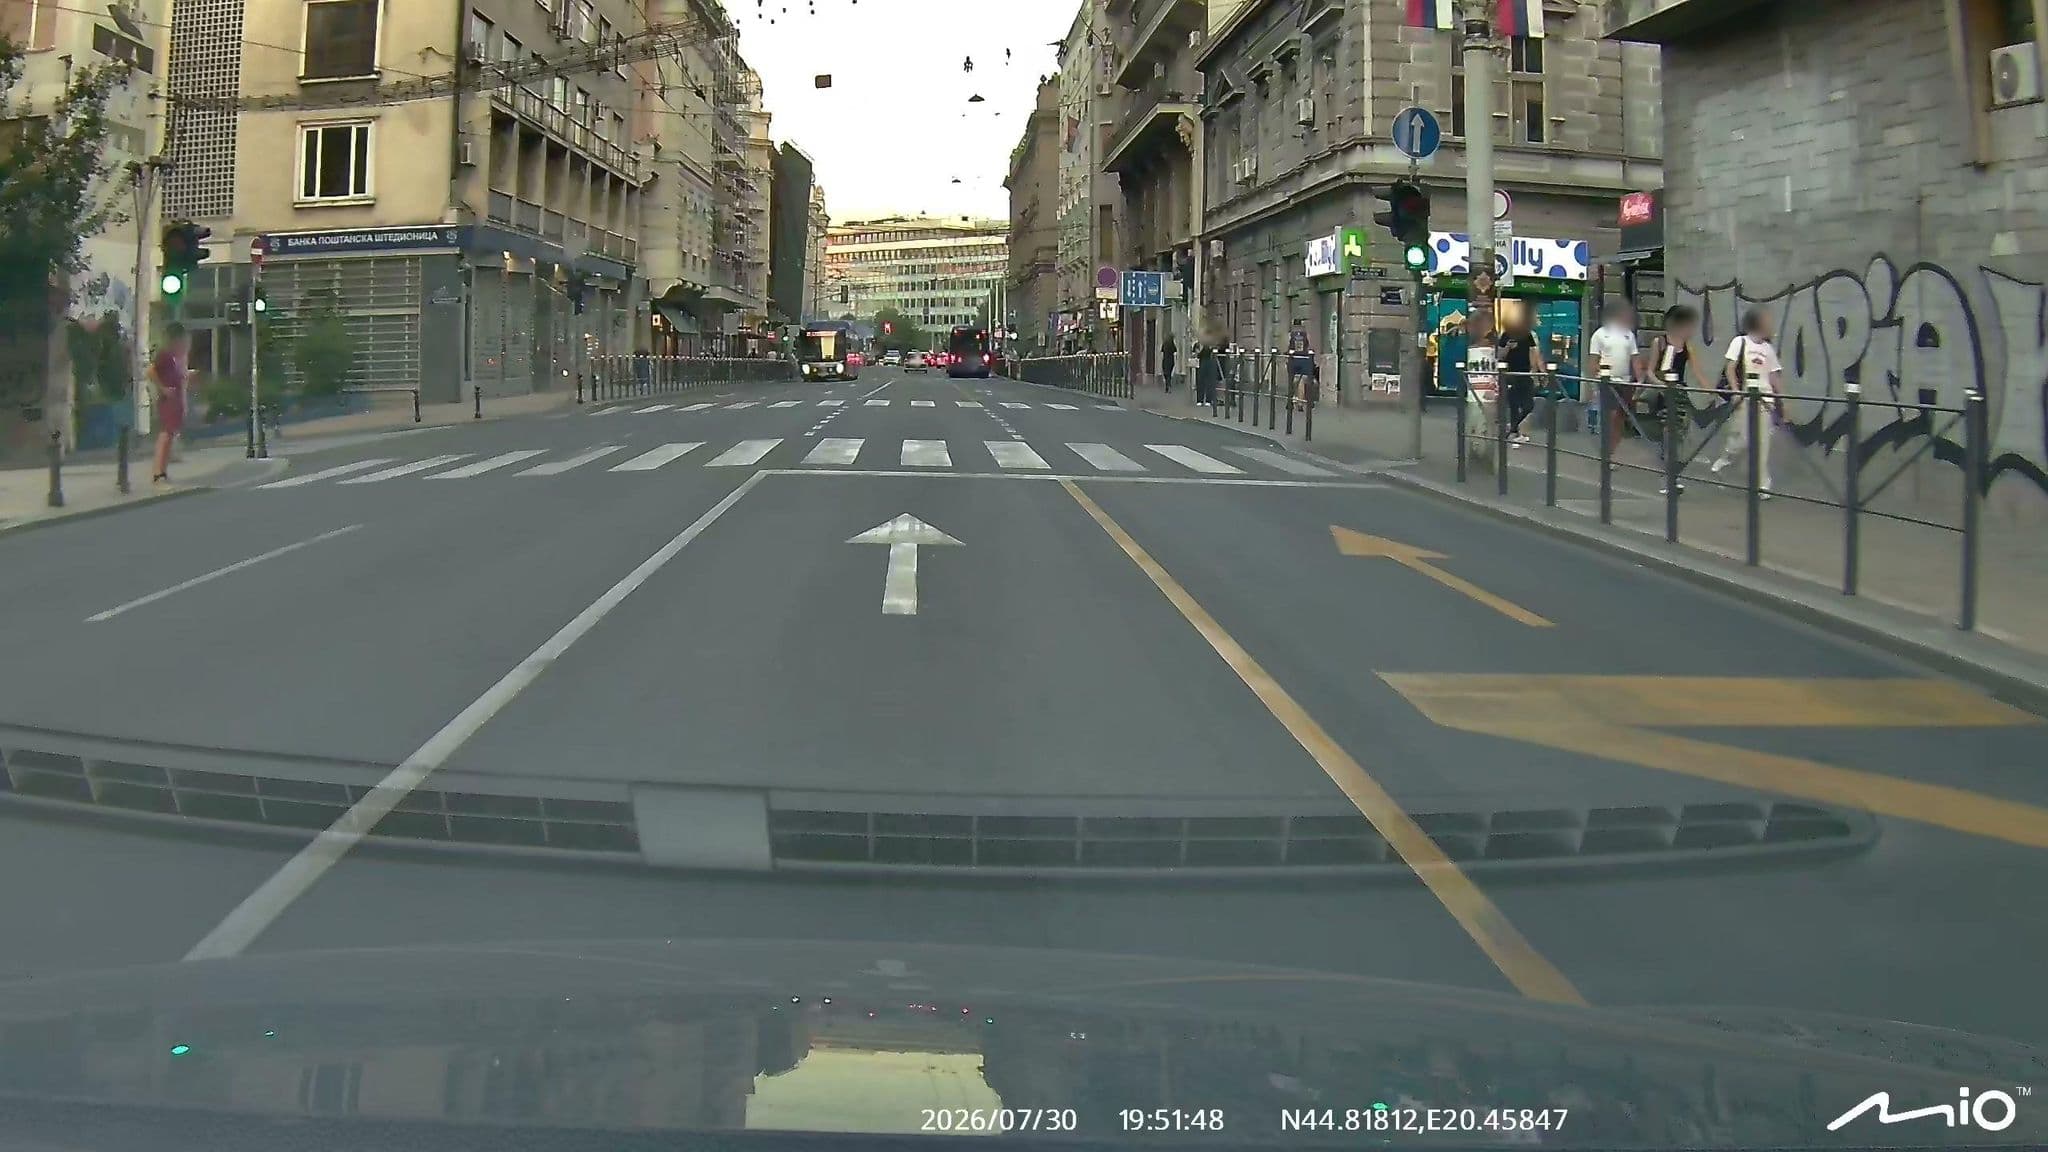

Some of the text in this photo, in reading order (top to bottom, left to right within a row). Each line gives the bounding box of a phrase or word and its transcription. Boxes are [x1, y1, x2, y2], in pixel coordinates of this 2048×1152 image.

[287, 231, 439, 247] БАНКА ПОШТАНСКА ШТЕДИОНИЦА
[1513, 239, 1543, 274] lly
